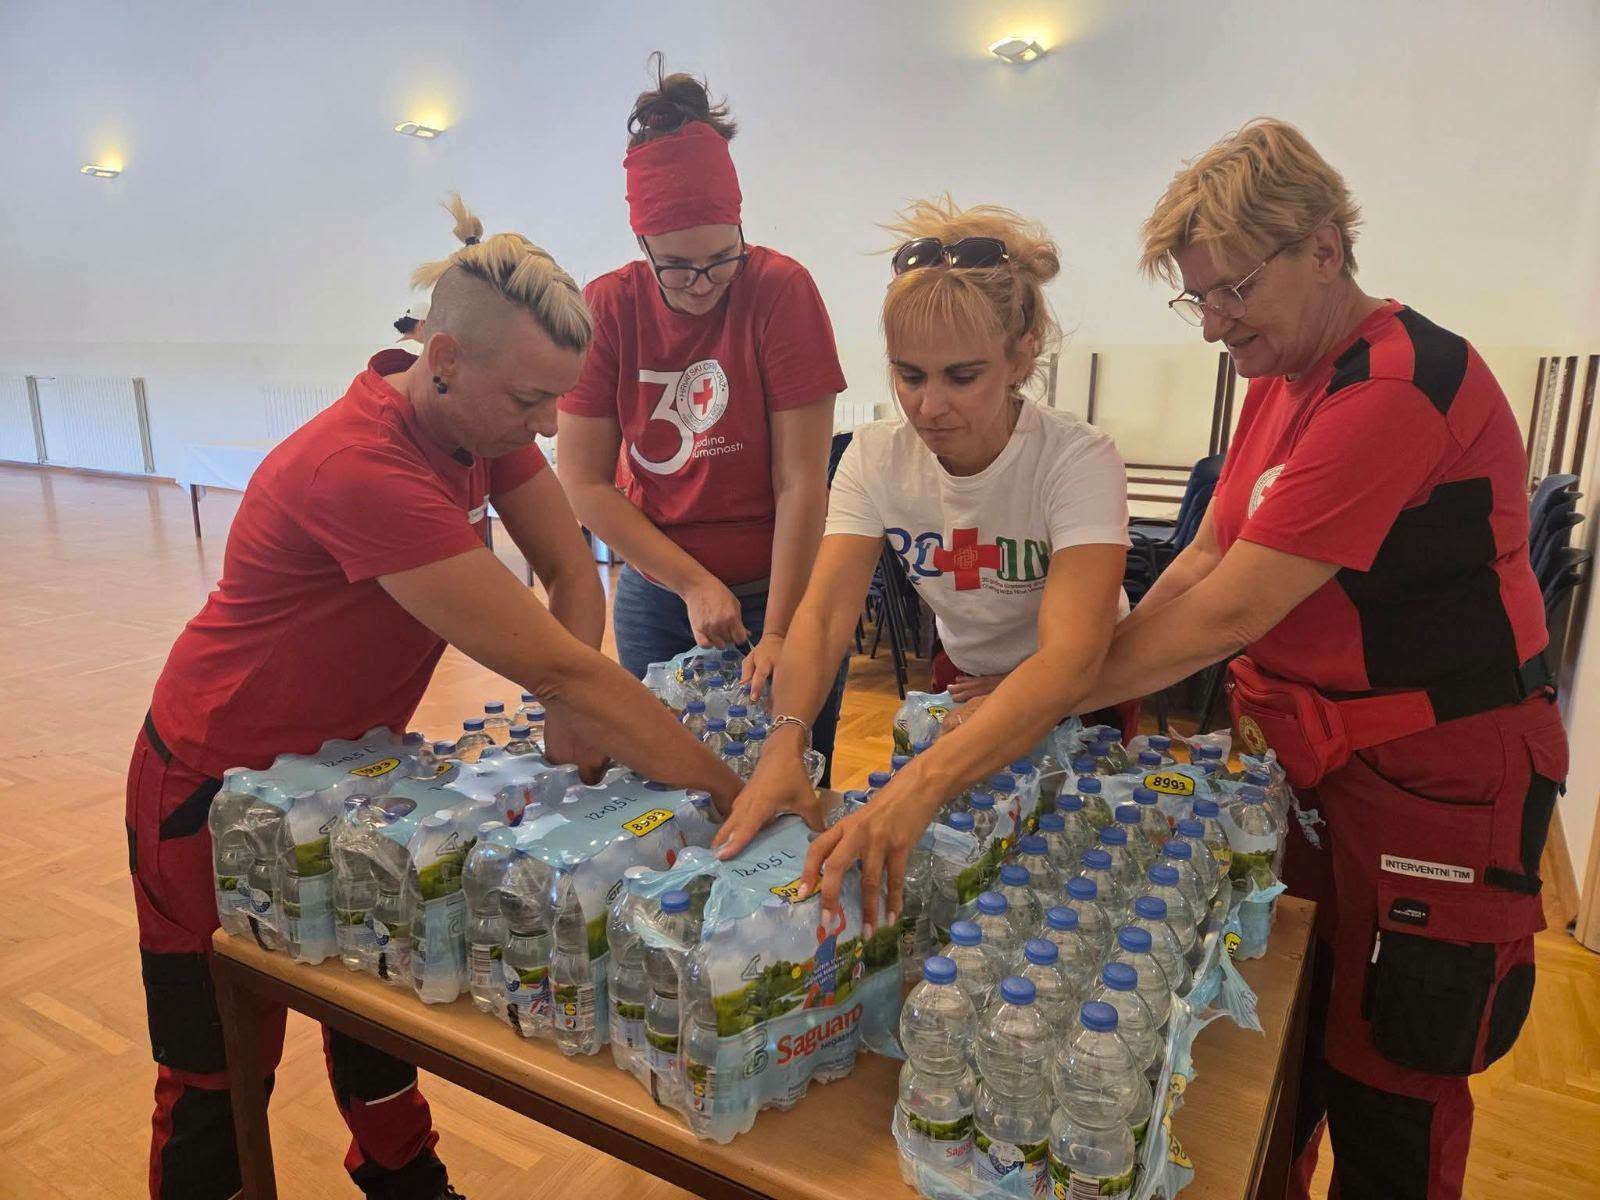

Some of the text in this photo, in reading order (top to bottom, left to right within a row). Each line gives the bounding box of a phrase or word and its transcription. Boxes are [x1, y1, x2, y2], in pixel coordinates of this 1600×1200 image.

[1153, 776, 1186, 791] 8993
[632, 811, 665, 831] 8993
[1385, 859, 1471, 880] INTERVENTNI TIM
[777, 1002, 864, 1065] Saguaro
